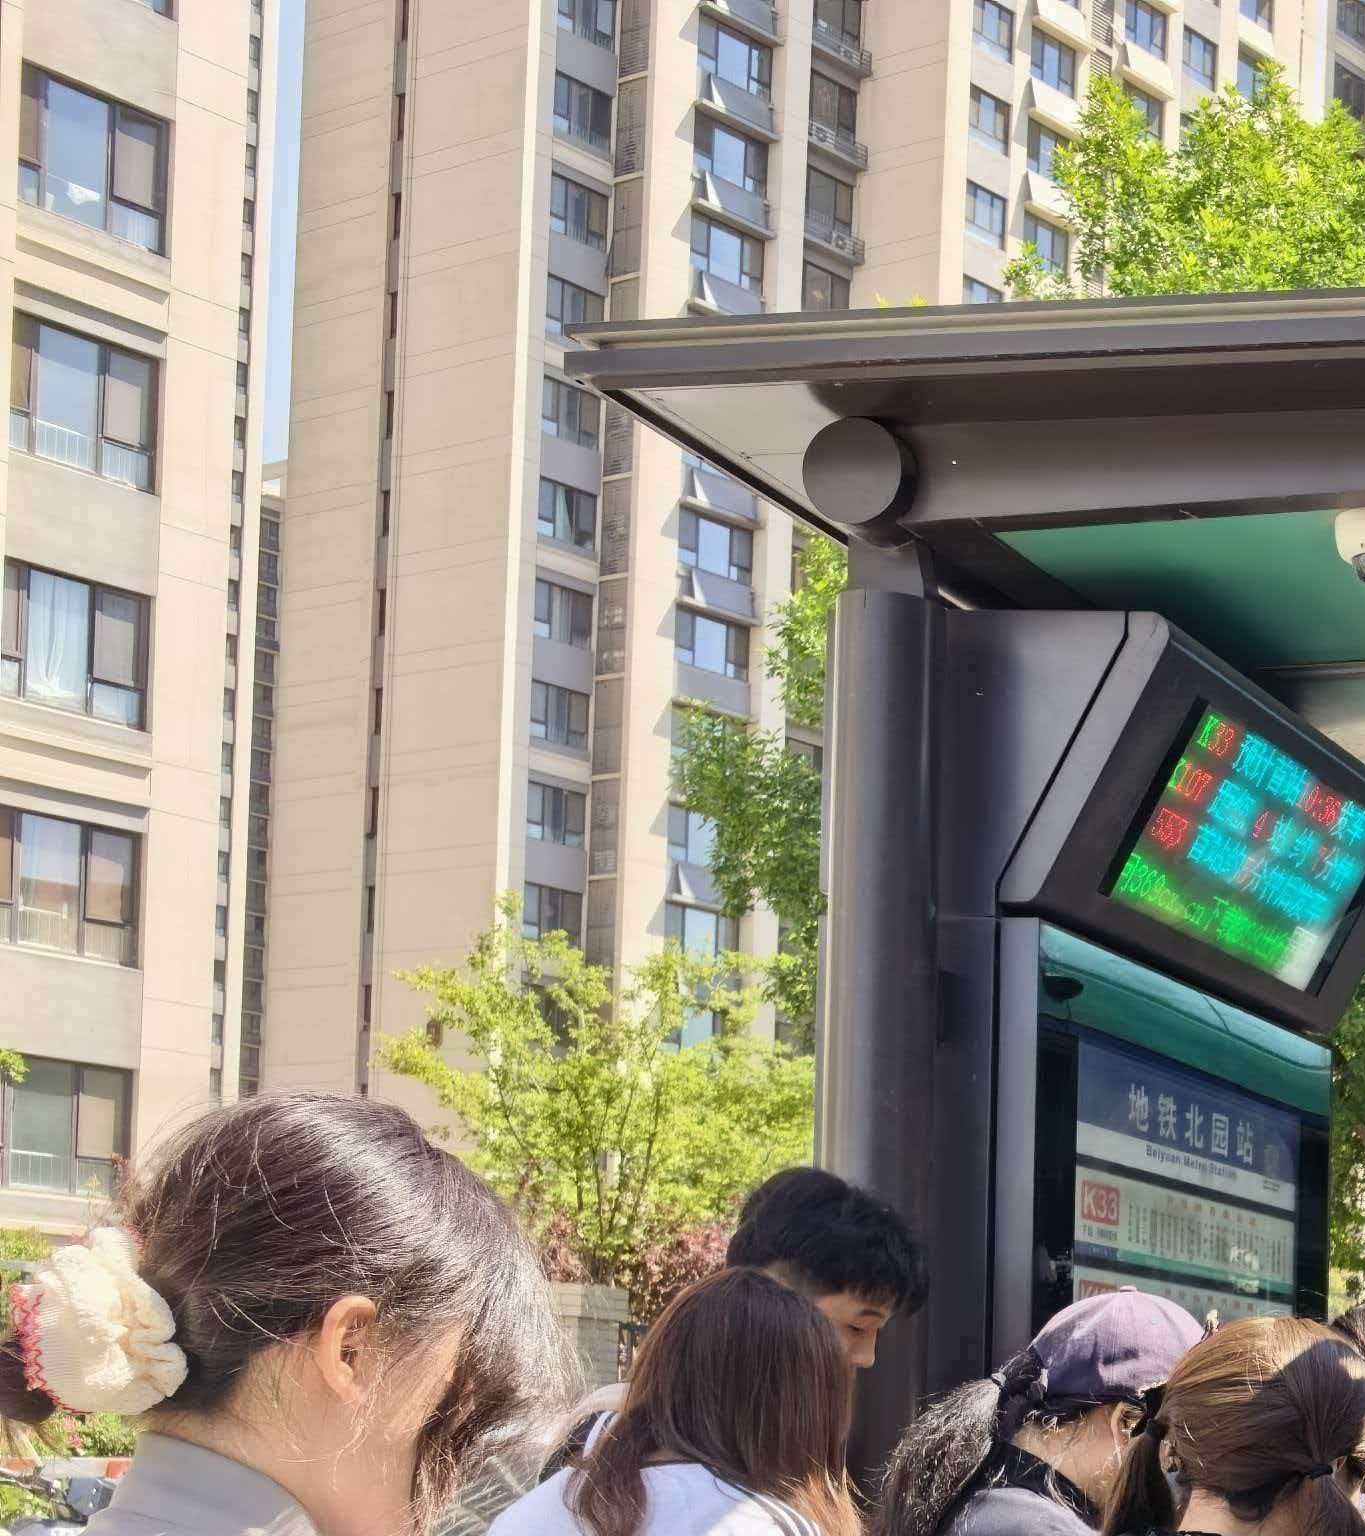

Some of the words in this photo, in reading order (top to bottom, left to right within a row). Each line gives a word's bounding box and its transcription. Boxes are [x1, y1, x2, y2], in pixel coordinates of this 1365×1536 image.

[1128, 1083, 1253, 1165] 地铁北园站
